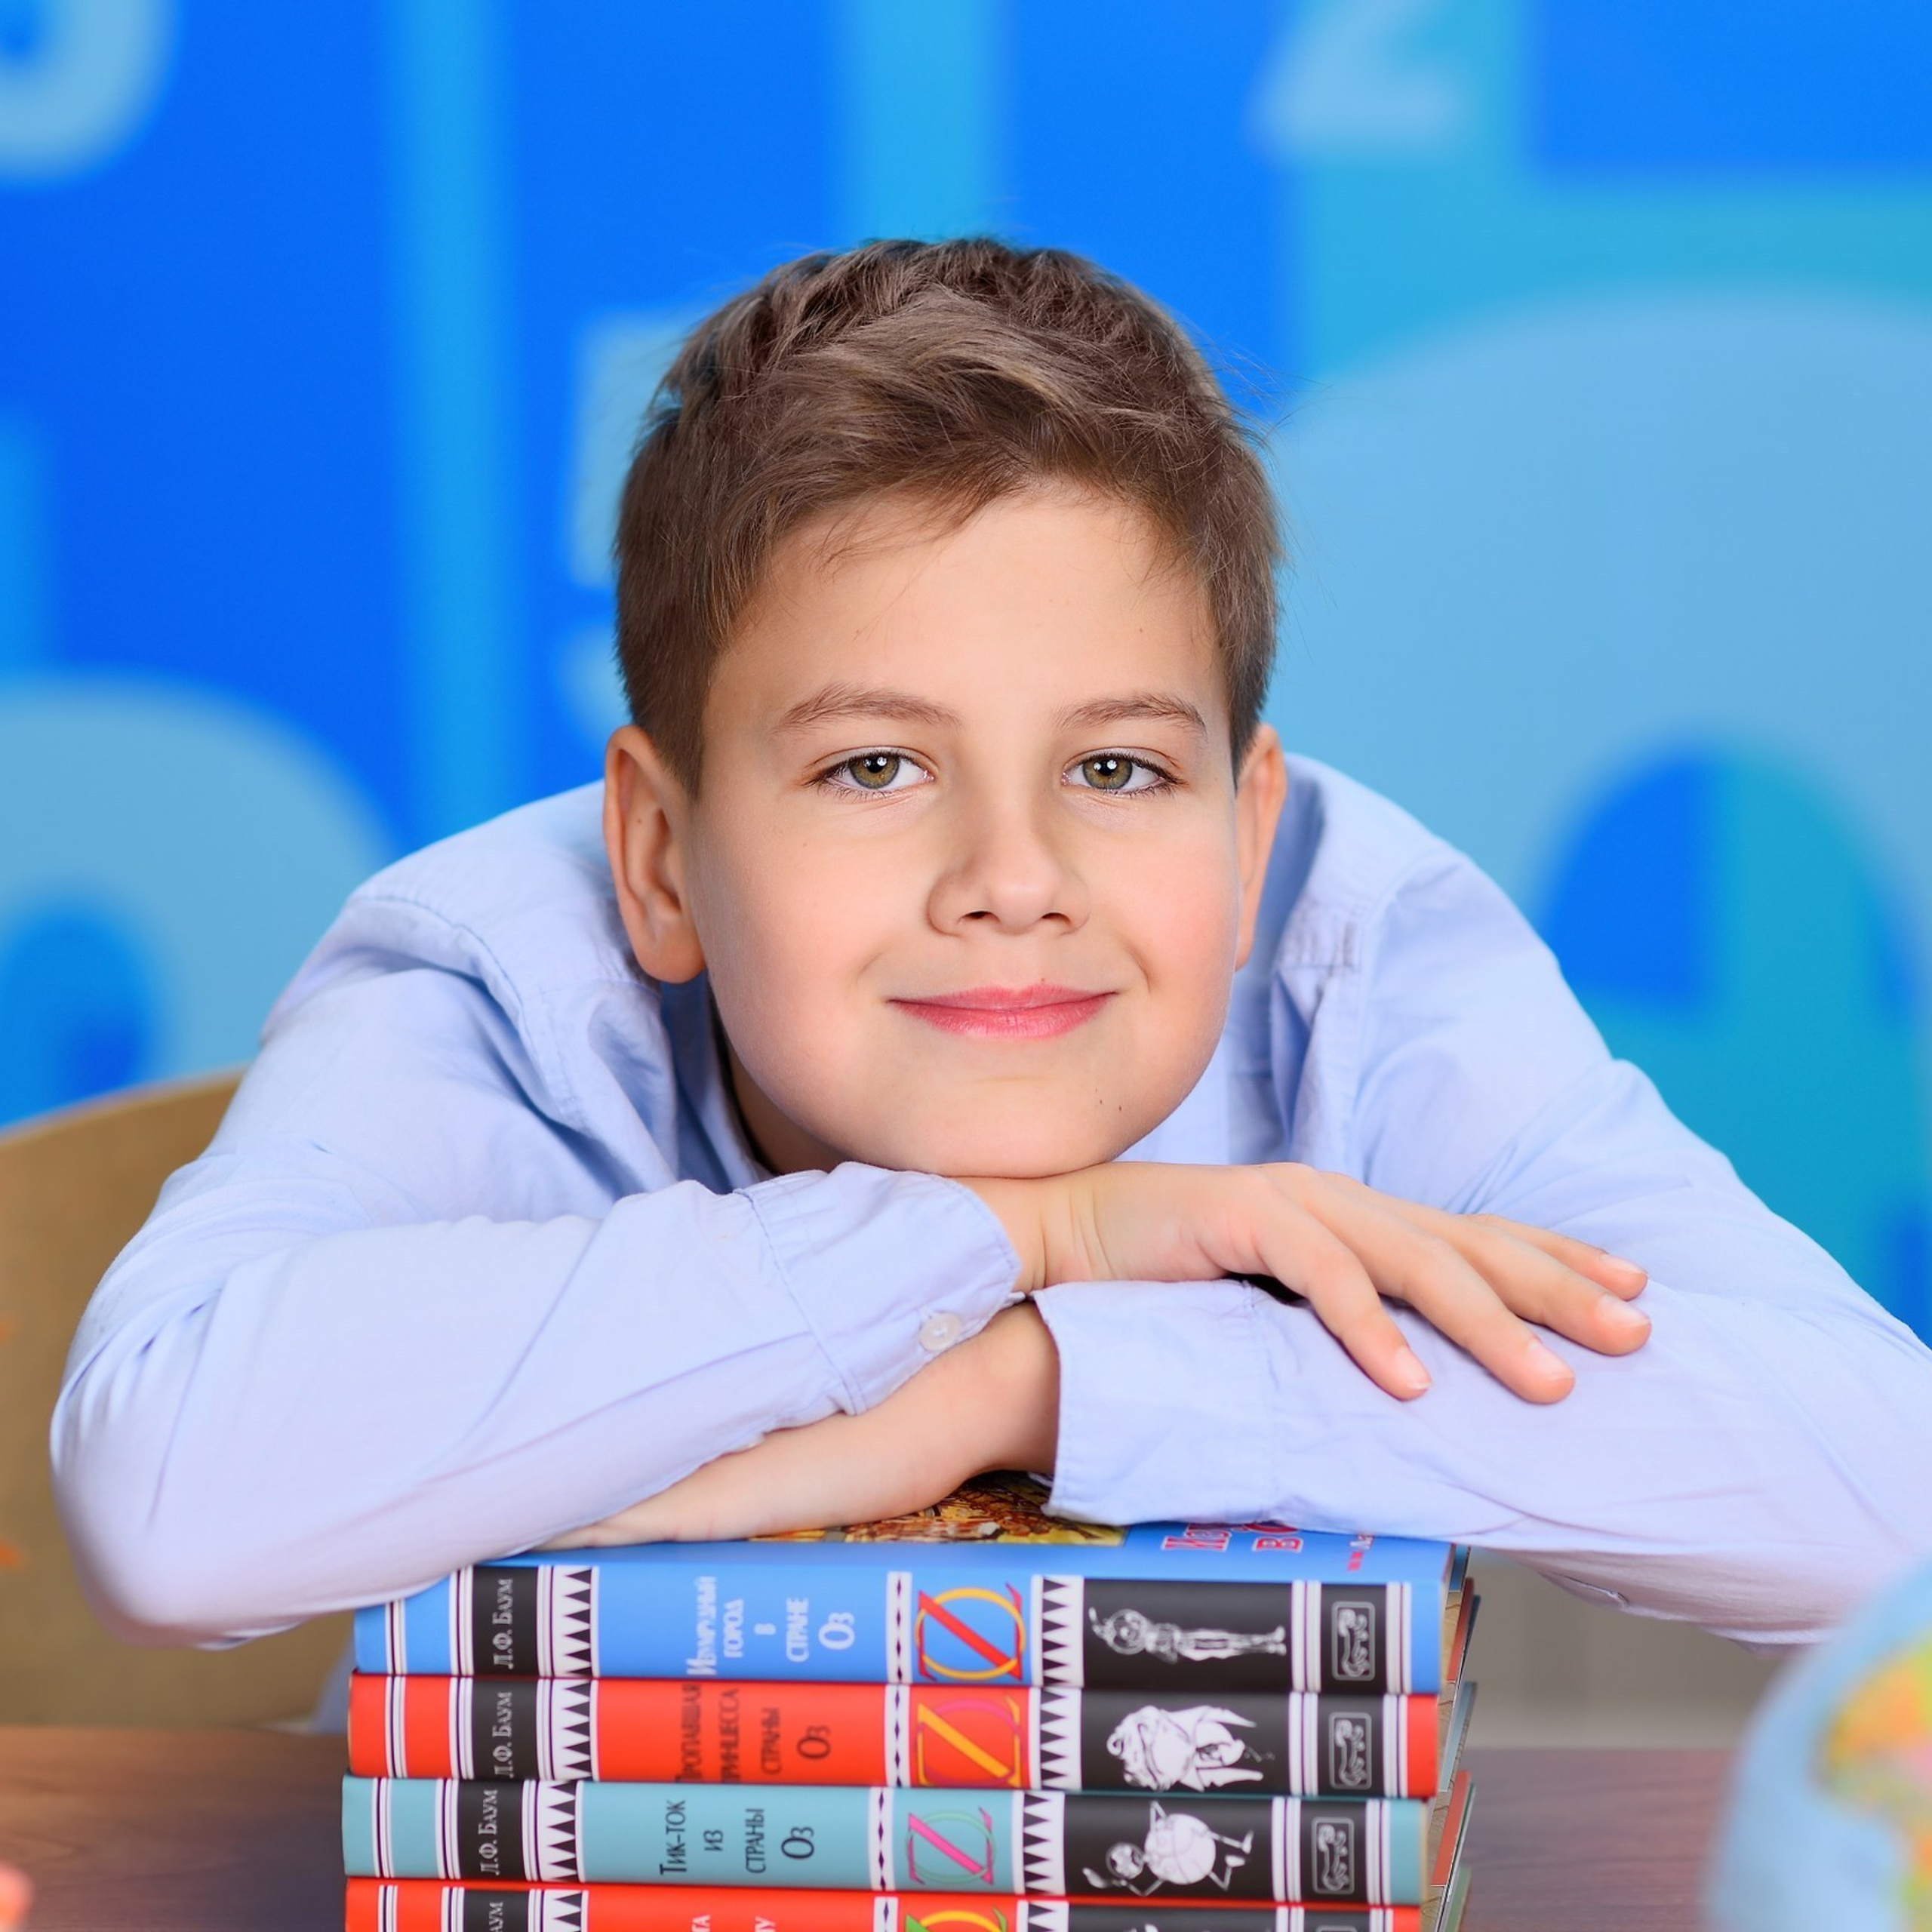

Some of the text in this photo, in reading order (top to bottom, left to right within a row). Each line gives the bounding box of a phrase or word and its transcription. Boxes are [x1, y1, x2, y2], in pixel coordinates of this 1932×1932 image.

[492, 1579, 513, 1625] БАУМ
[492, 1692, 512, 1737] БАУМ
[478, 1789, 500, 1875] Л.Ф. БАУМ
[660, 1800, 687, 1875] ТИК-ТОК
[745, 1808, 767, 1873] СТРАНЫ
[489, 1902, 503, 1932] АУМ
